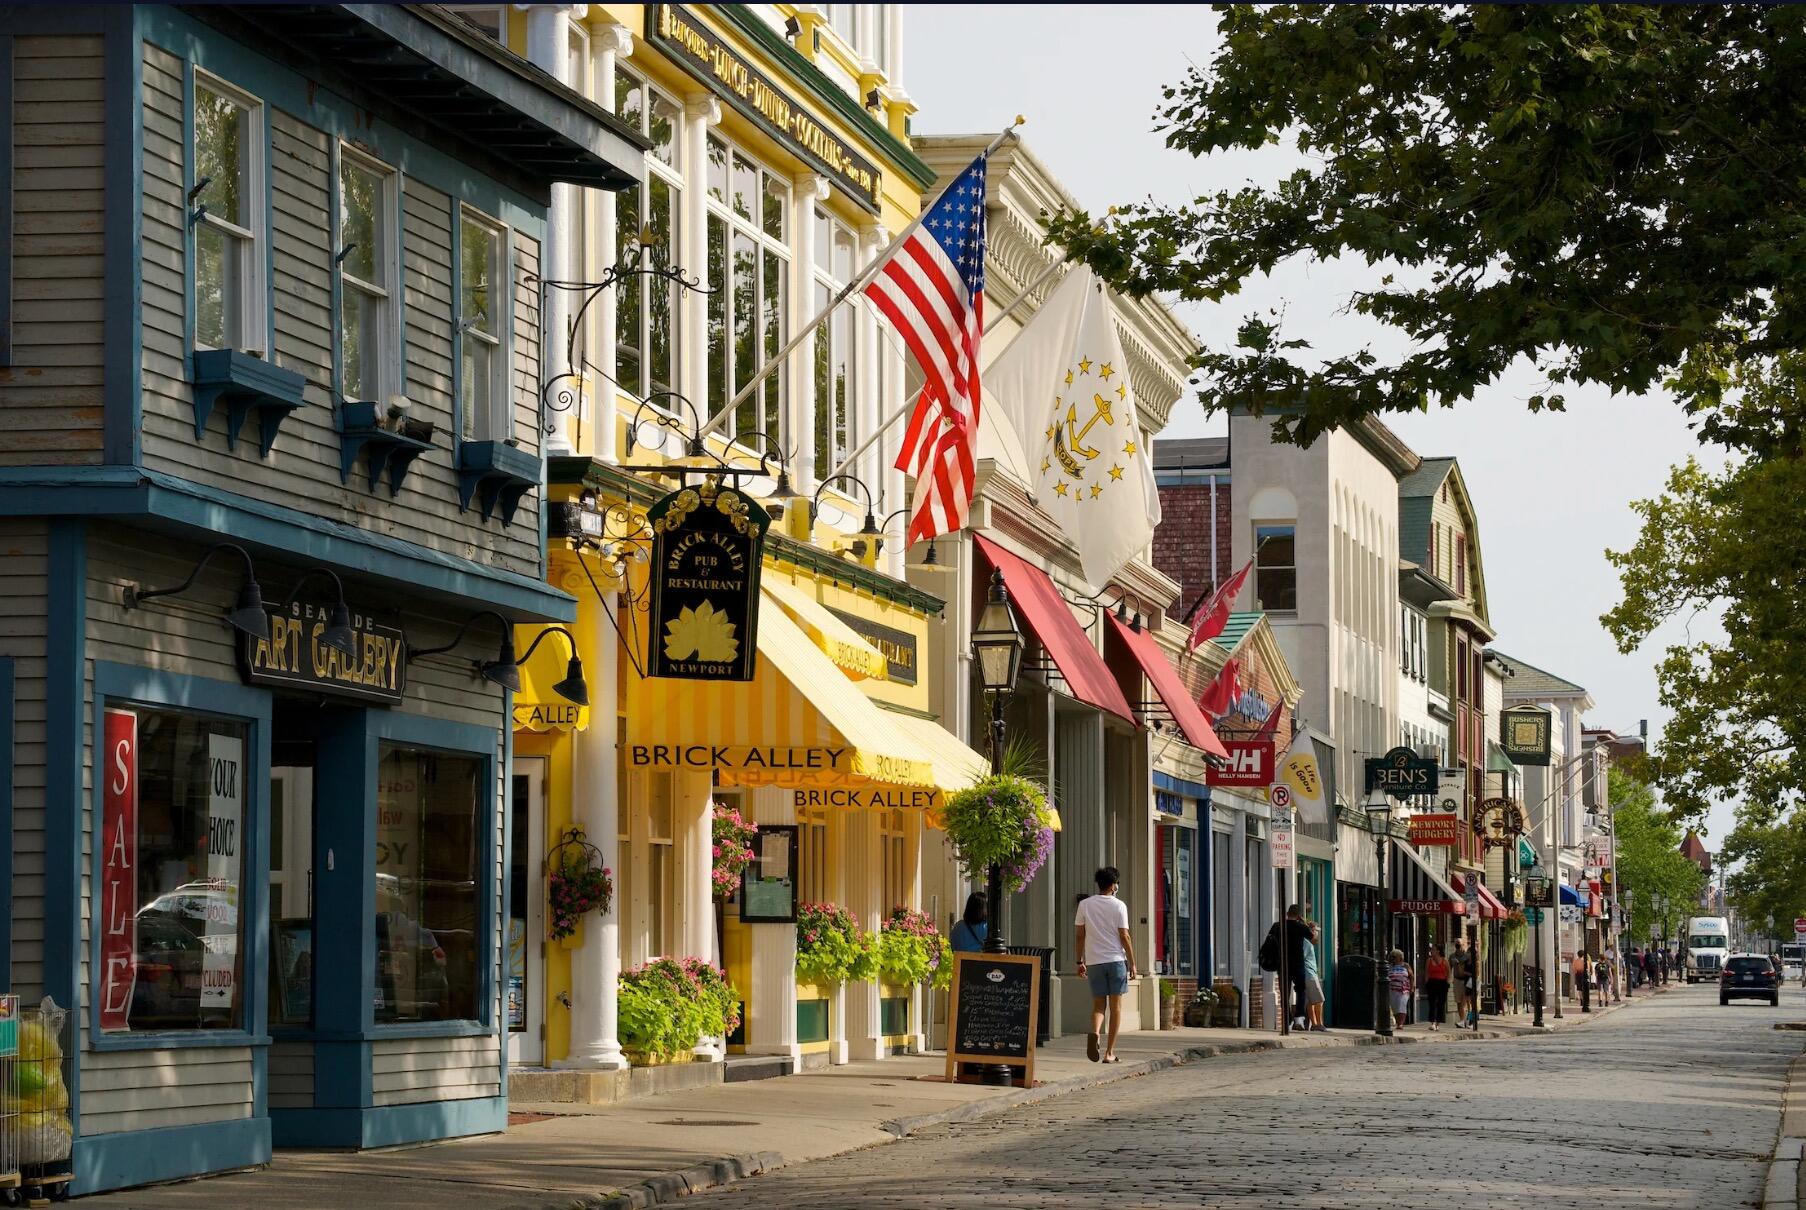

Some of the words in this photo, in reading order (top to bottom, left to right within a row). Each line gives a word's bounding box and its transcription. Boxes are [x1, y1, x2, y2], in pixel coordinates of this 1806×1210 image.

[714, 44, 748, 98] LUNCH
[753, 77, 790, 133] DINNER
[668, 531, 706, 570] BRICK
[710, 532, 744, 574] ALLEY
[694, 555, 718, 567] PUB
[668, 577, 743, 591] RESTAURANT
[292, 601, 374, 631] SEADE
[254, 615, 303, 673] ART
[669, 663, 734, 675] NEWPORT
[529, 706, 580, 724] ALLEY
[632, 745, 732, 767] BRICK
[743, 747, 846, 769] ALLEY
[794, 790, 862, 807] BRICK
[869, 791, 938, 808] ALLEY
[1411, 820, 1455, 829] NEWPORT
[1412, 829, 1455, 838] FUDGERY
[1401, 901, 1440, 911] FUDGE
